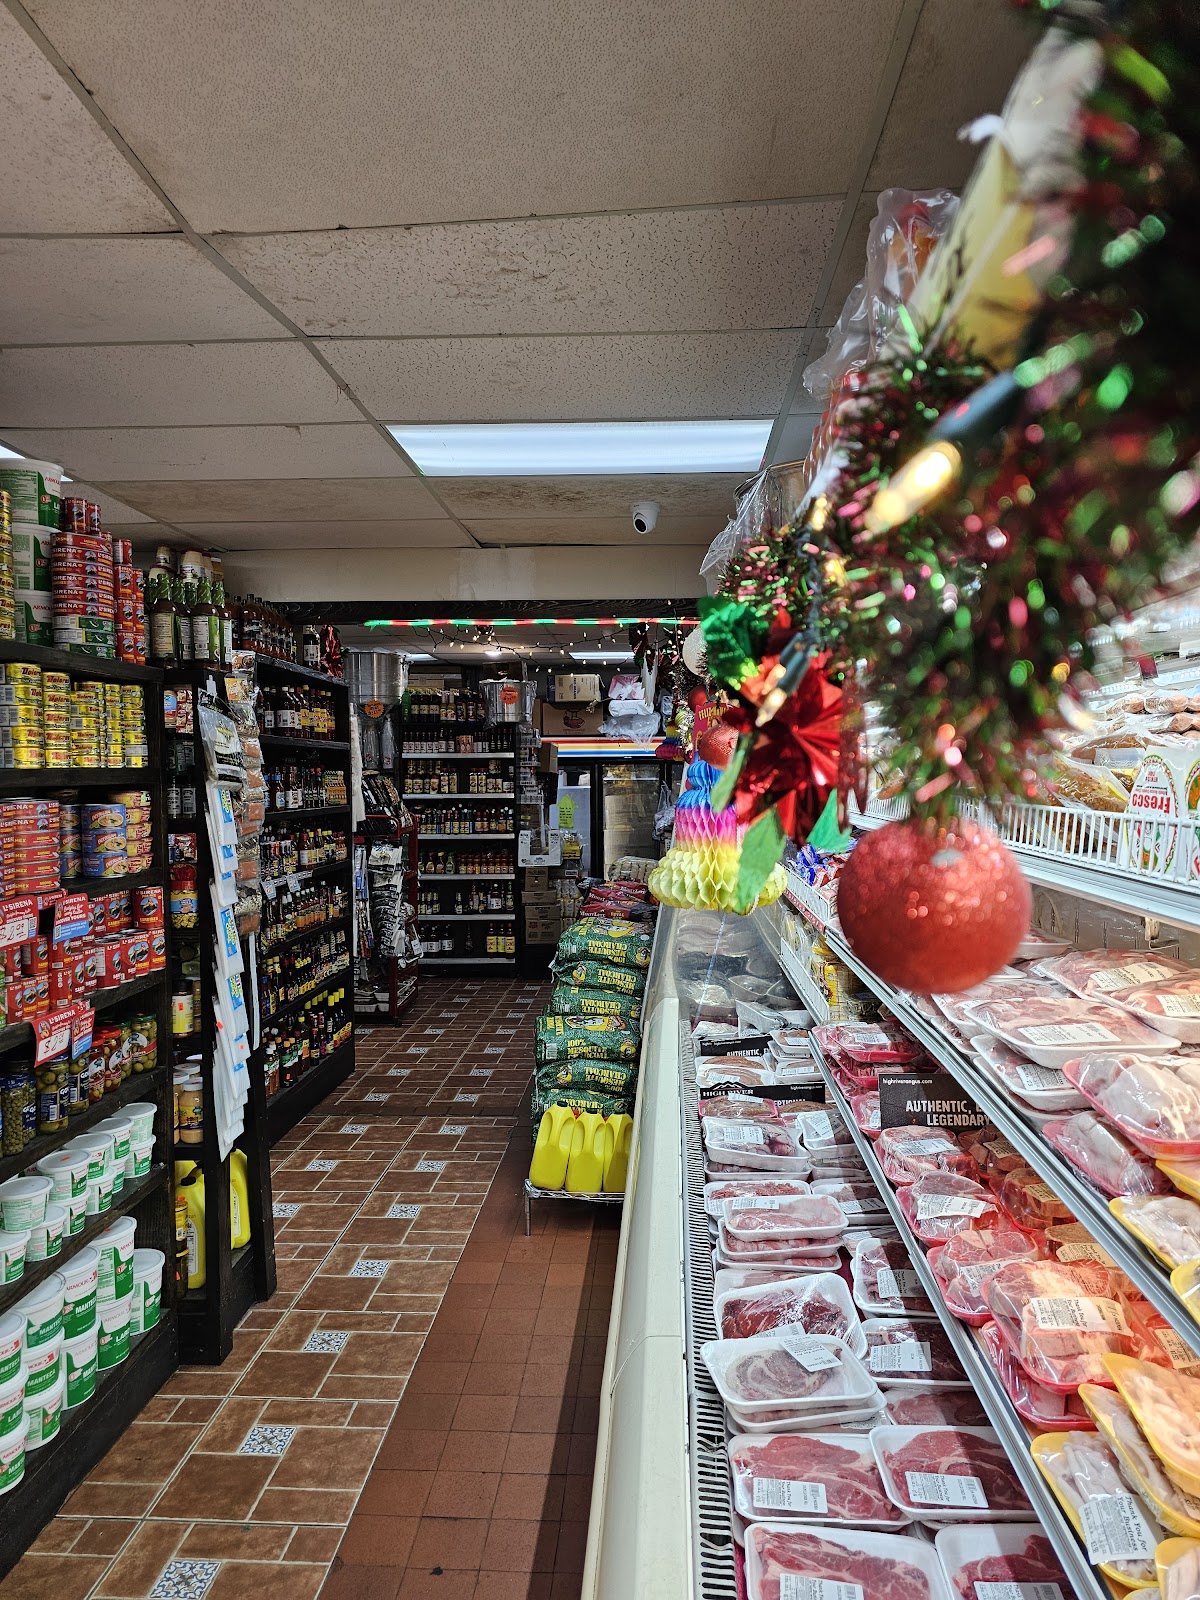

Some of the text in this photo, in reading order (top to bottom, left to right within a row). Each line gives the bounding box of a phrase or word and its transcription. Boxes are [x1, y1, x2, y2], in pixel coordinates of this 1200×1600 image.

[1132, 793, 1171, 814] Fresco
[8, 899, 33, 911] SIRENA
[587, 940, 628, 950] CHARCOAL
[588, 945, 627, 958] MESQUITE
[597, 969, 637, 983] CHARCOAL
[597, 975, 636, 990] MESQUITE
[580, 998, 622, 1010] CHARCOAL
[54, 1010, 76, 1022] SIRENA
[585, 1067, 627, 1081] CHARCOAL
[883, 1077, 933, 1086] highriverangus.com
[905, 1100, 972, 1115] AUTHENTIC,
[926, 1113, 991, 1127] LEGENDARY
[27, 1368, 56, 1387] MANTECA
[1117, 1496, 1139, 1552] Your Business
[1125, 1496, 1148, 1552] Thank You for
